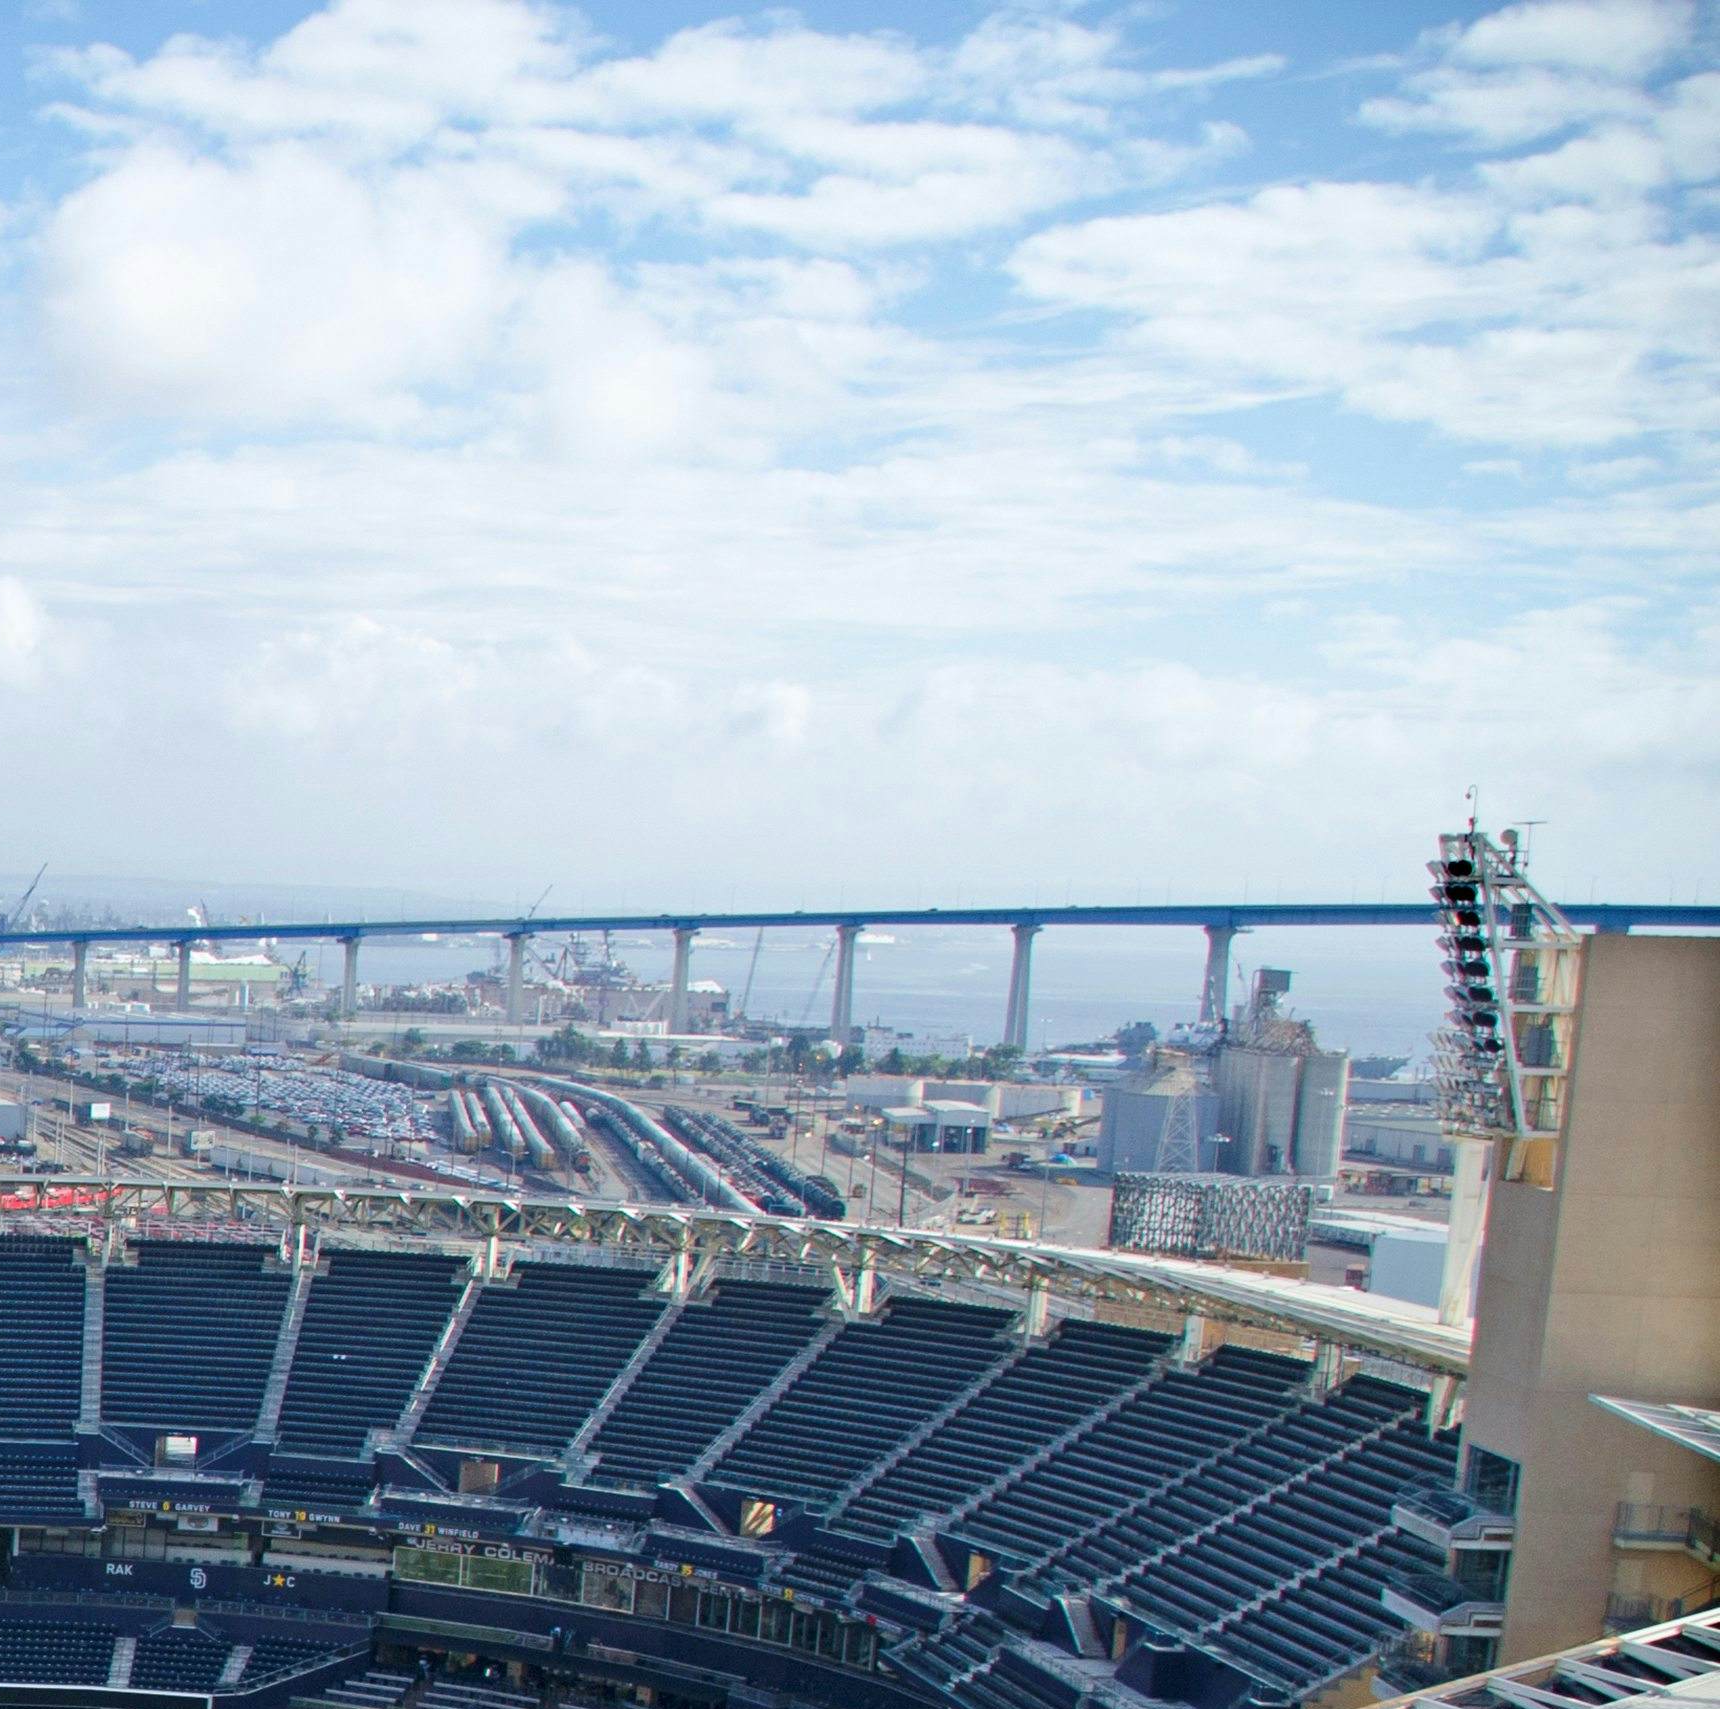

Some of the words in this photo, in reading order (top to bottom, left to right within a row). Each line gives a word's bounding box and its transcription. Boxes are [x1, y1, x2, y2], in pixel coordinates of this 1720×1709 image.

[129, 1500, 158, 1510] STEVE
[175, 1503, 210, 1513] GARVEY
[268, 1510, 291, 1520] TONY
[398, 1522, 421, 1532] DAVE
[438, 1527, 479, 1539] WINFIELD
[106, 1563, 133, 1576] RAK
